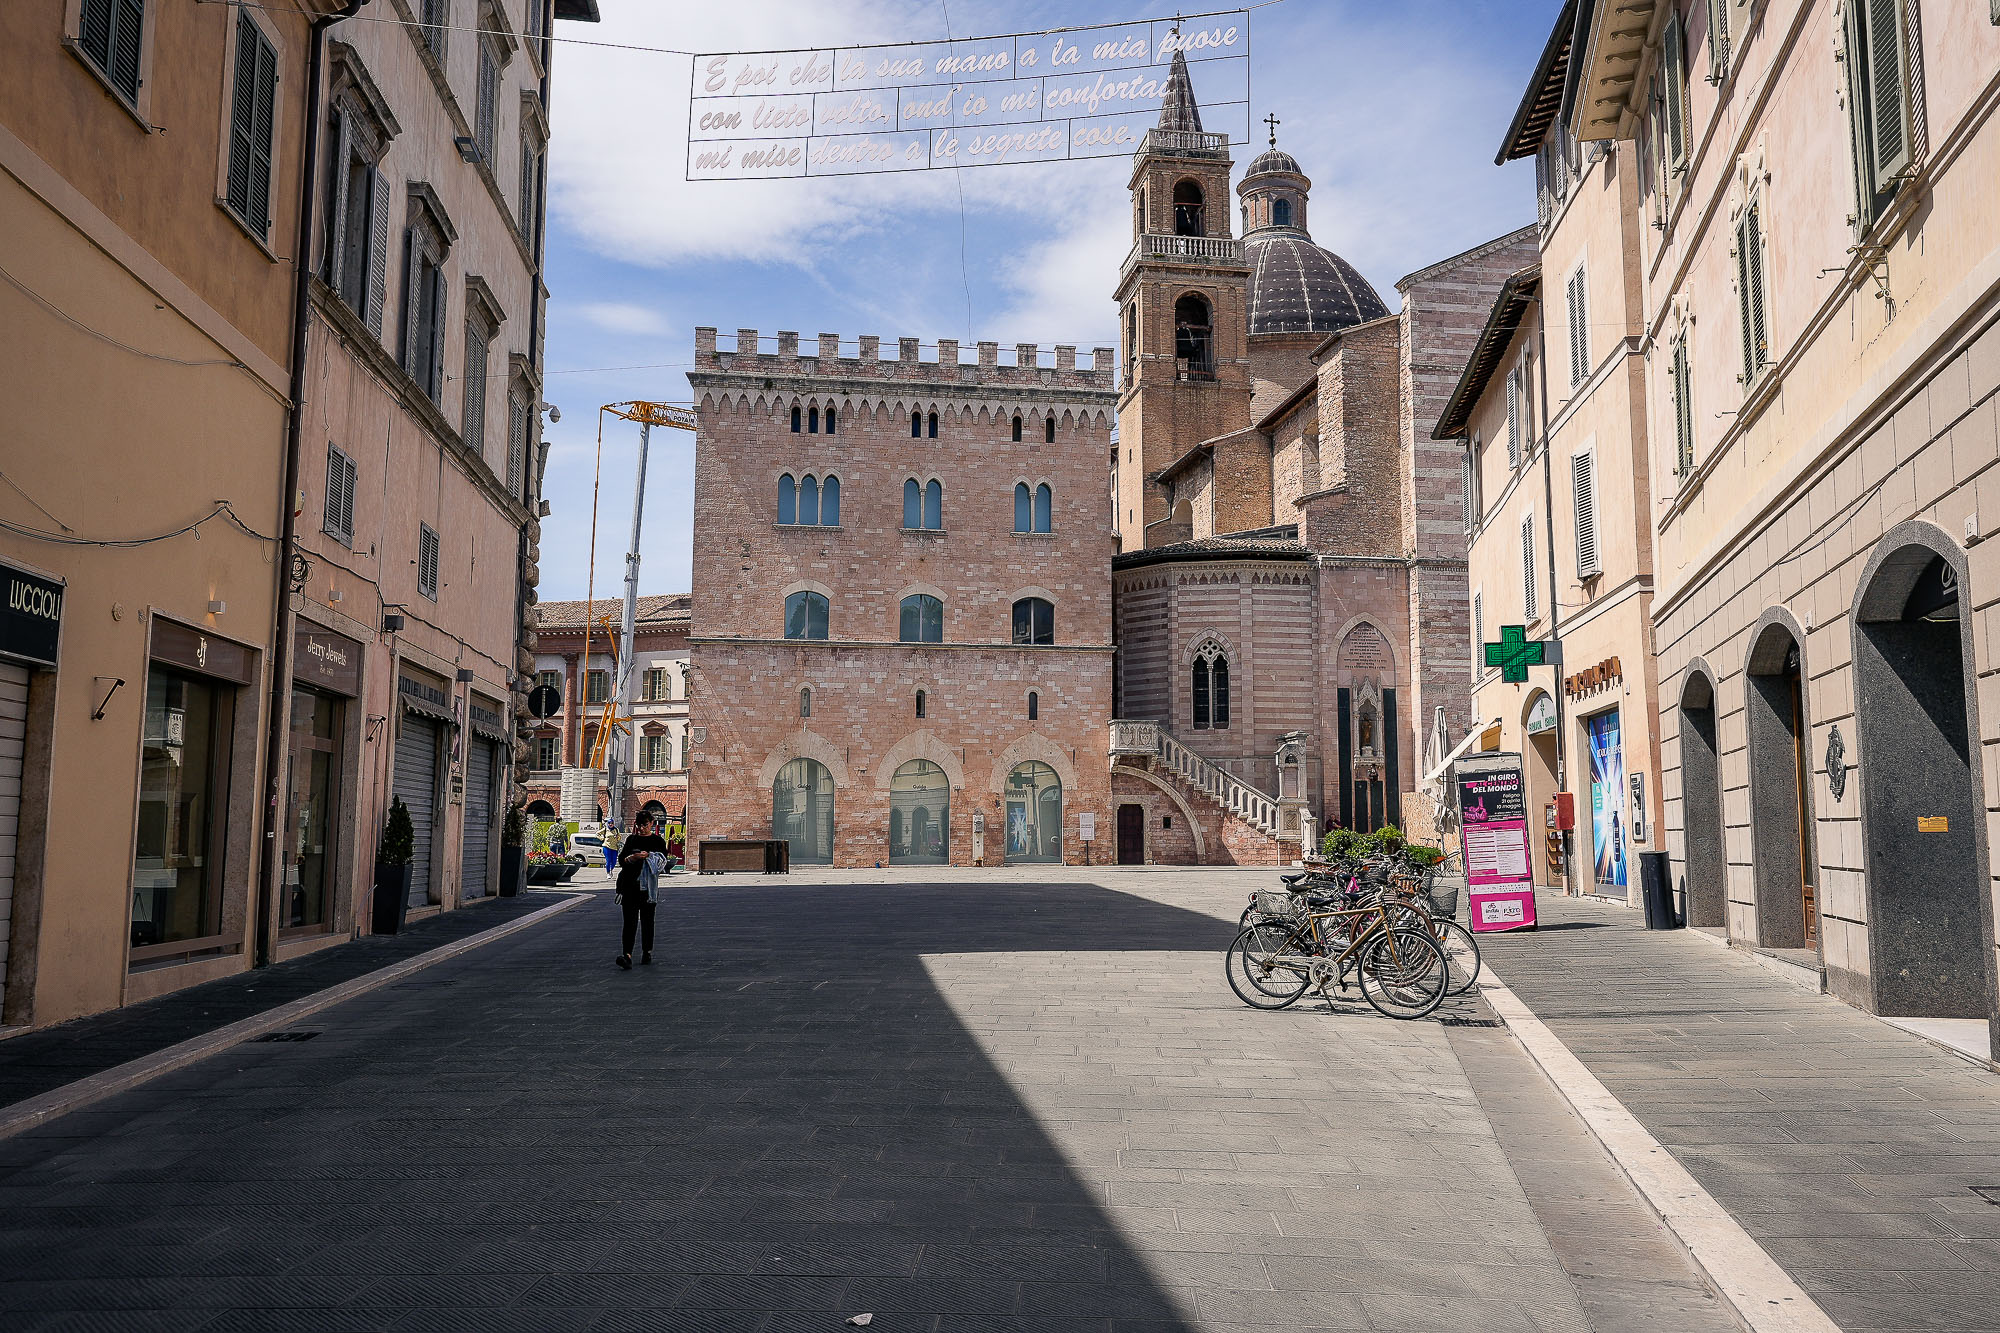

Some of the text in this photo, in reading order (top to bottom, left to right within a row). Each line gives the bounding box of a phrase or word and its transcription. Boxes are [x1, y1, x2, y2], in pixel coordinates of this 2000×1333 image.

[704, 25, 1240, 95] E poi che la sua mano a la mia puose
[699, 111, 743, 131] con
[752, 99, 810, 130] lieto
[818, 95, 891, 125] volto,
[1000, 85, 1039, 113] mi
[695, 146, 733, 170] mi
[740, 143, 802, 169] mise
[811, 136, 895, 165] dentro
[905, 140, 924, 161] a
[934, 129, 961, 159] le
[967, 125, 1063, 164] segrete
[9, 579, 61, 621] LUCCIOLI
[308, 636, 346, 666] Jerry Jewels
